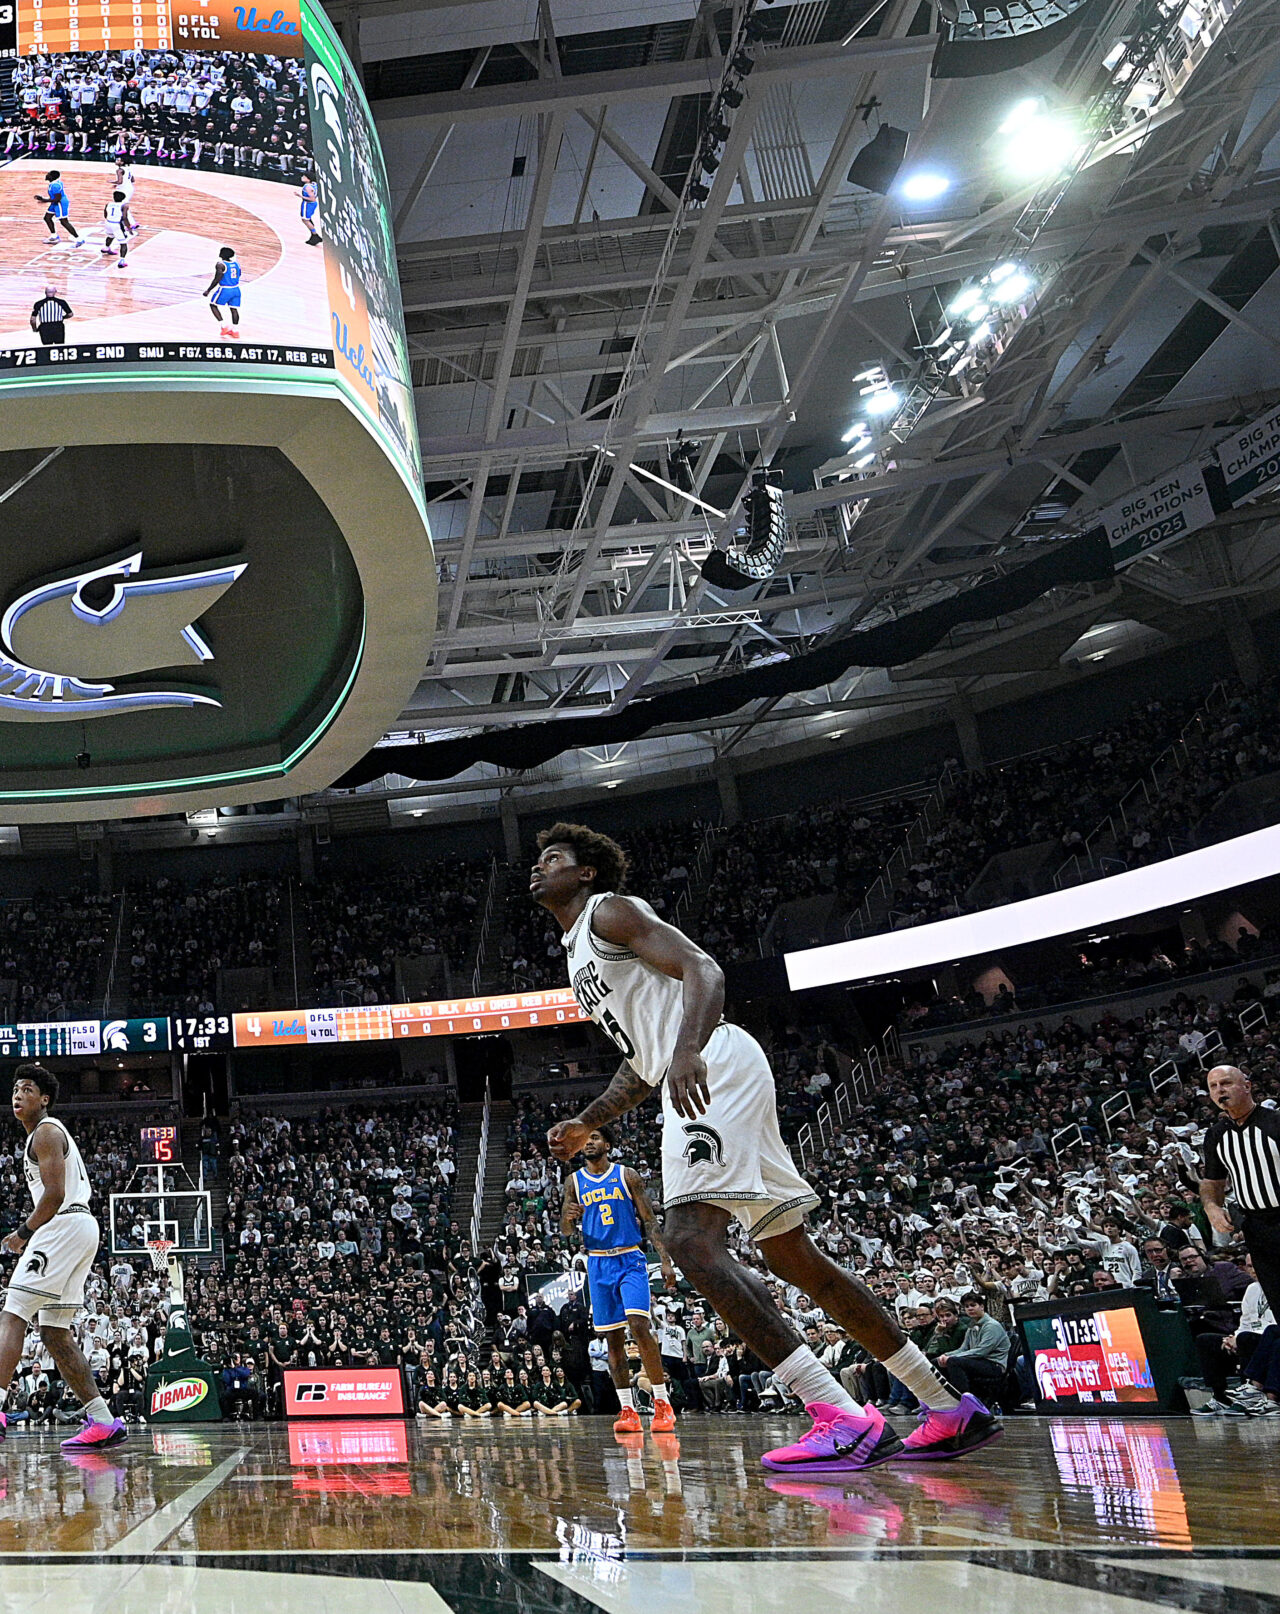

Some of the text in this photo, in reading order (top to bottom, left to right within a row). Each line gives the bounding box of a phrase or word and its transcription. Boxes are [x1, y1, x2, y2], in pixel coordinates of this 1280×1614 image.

[33, 16, 108, 31] 2 2 1
[35, 9, 41, 20] 1
[191, 15, 219, 27] FLS
[234, 6, 300, 36] Ucla
[34, 32, 43, 43] 3
[178, 27, 220, 39] 4 TOL
[28, 39, 109, 55] 34 2 1
[15, 350, 36, 365] 72
[50, 348, 77, 361] 8:13
[96, 346, 125, 359] 2ND
[139, 347, 164, 358] SMU
[240, 348, 263, 359] AST
[286, 351, 307, 362] REB
[311, 353, 327, 364] 24
[1239, 428, 1263, 451] BIG
[1121, 479, 1181, 518] BIG TEN
[1111, 483, 1204, 540] CHAMPIONS
[1138, 511, 1183, 548] 2025
[465, 1001, 485, 1012] AST
[176, 1017, 229, 1036] 17:33
[247, 1017, 262, 1037] 4
[318, 1013, 334, 1022] FLS
[72, 1026, 87, 1034] FLS
[143, 1022, 157, 1042] 3
[272, 1018, 306, 1037] Ucla
[319, 1029, 335, 1037] TOL
[401, 1024, 409, 1035] 0
[423, 1022, 431, 1034] 0
[73, 1041, 88, 1049] TOL
[154, 1140, 172, 1161] 15
[581, 1187, 625, 1207] UCLA
[599, 1204, 614, 1225] 2
[1051, 1318, 1066, 1351] 3
[1064, 1318, 1100, 1345] 17:33
[331, 1382, 392, 1391] FARM BUREAU
[337, 1391, 389, 1400] INSURANCE
[152, 1382, 203, 1414] LIBMAN
